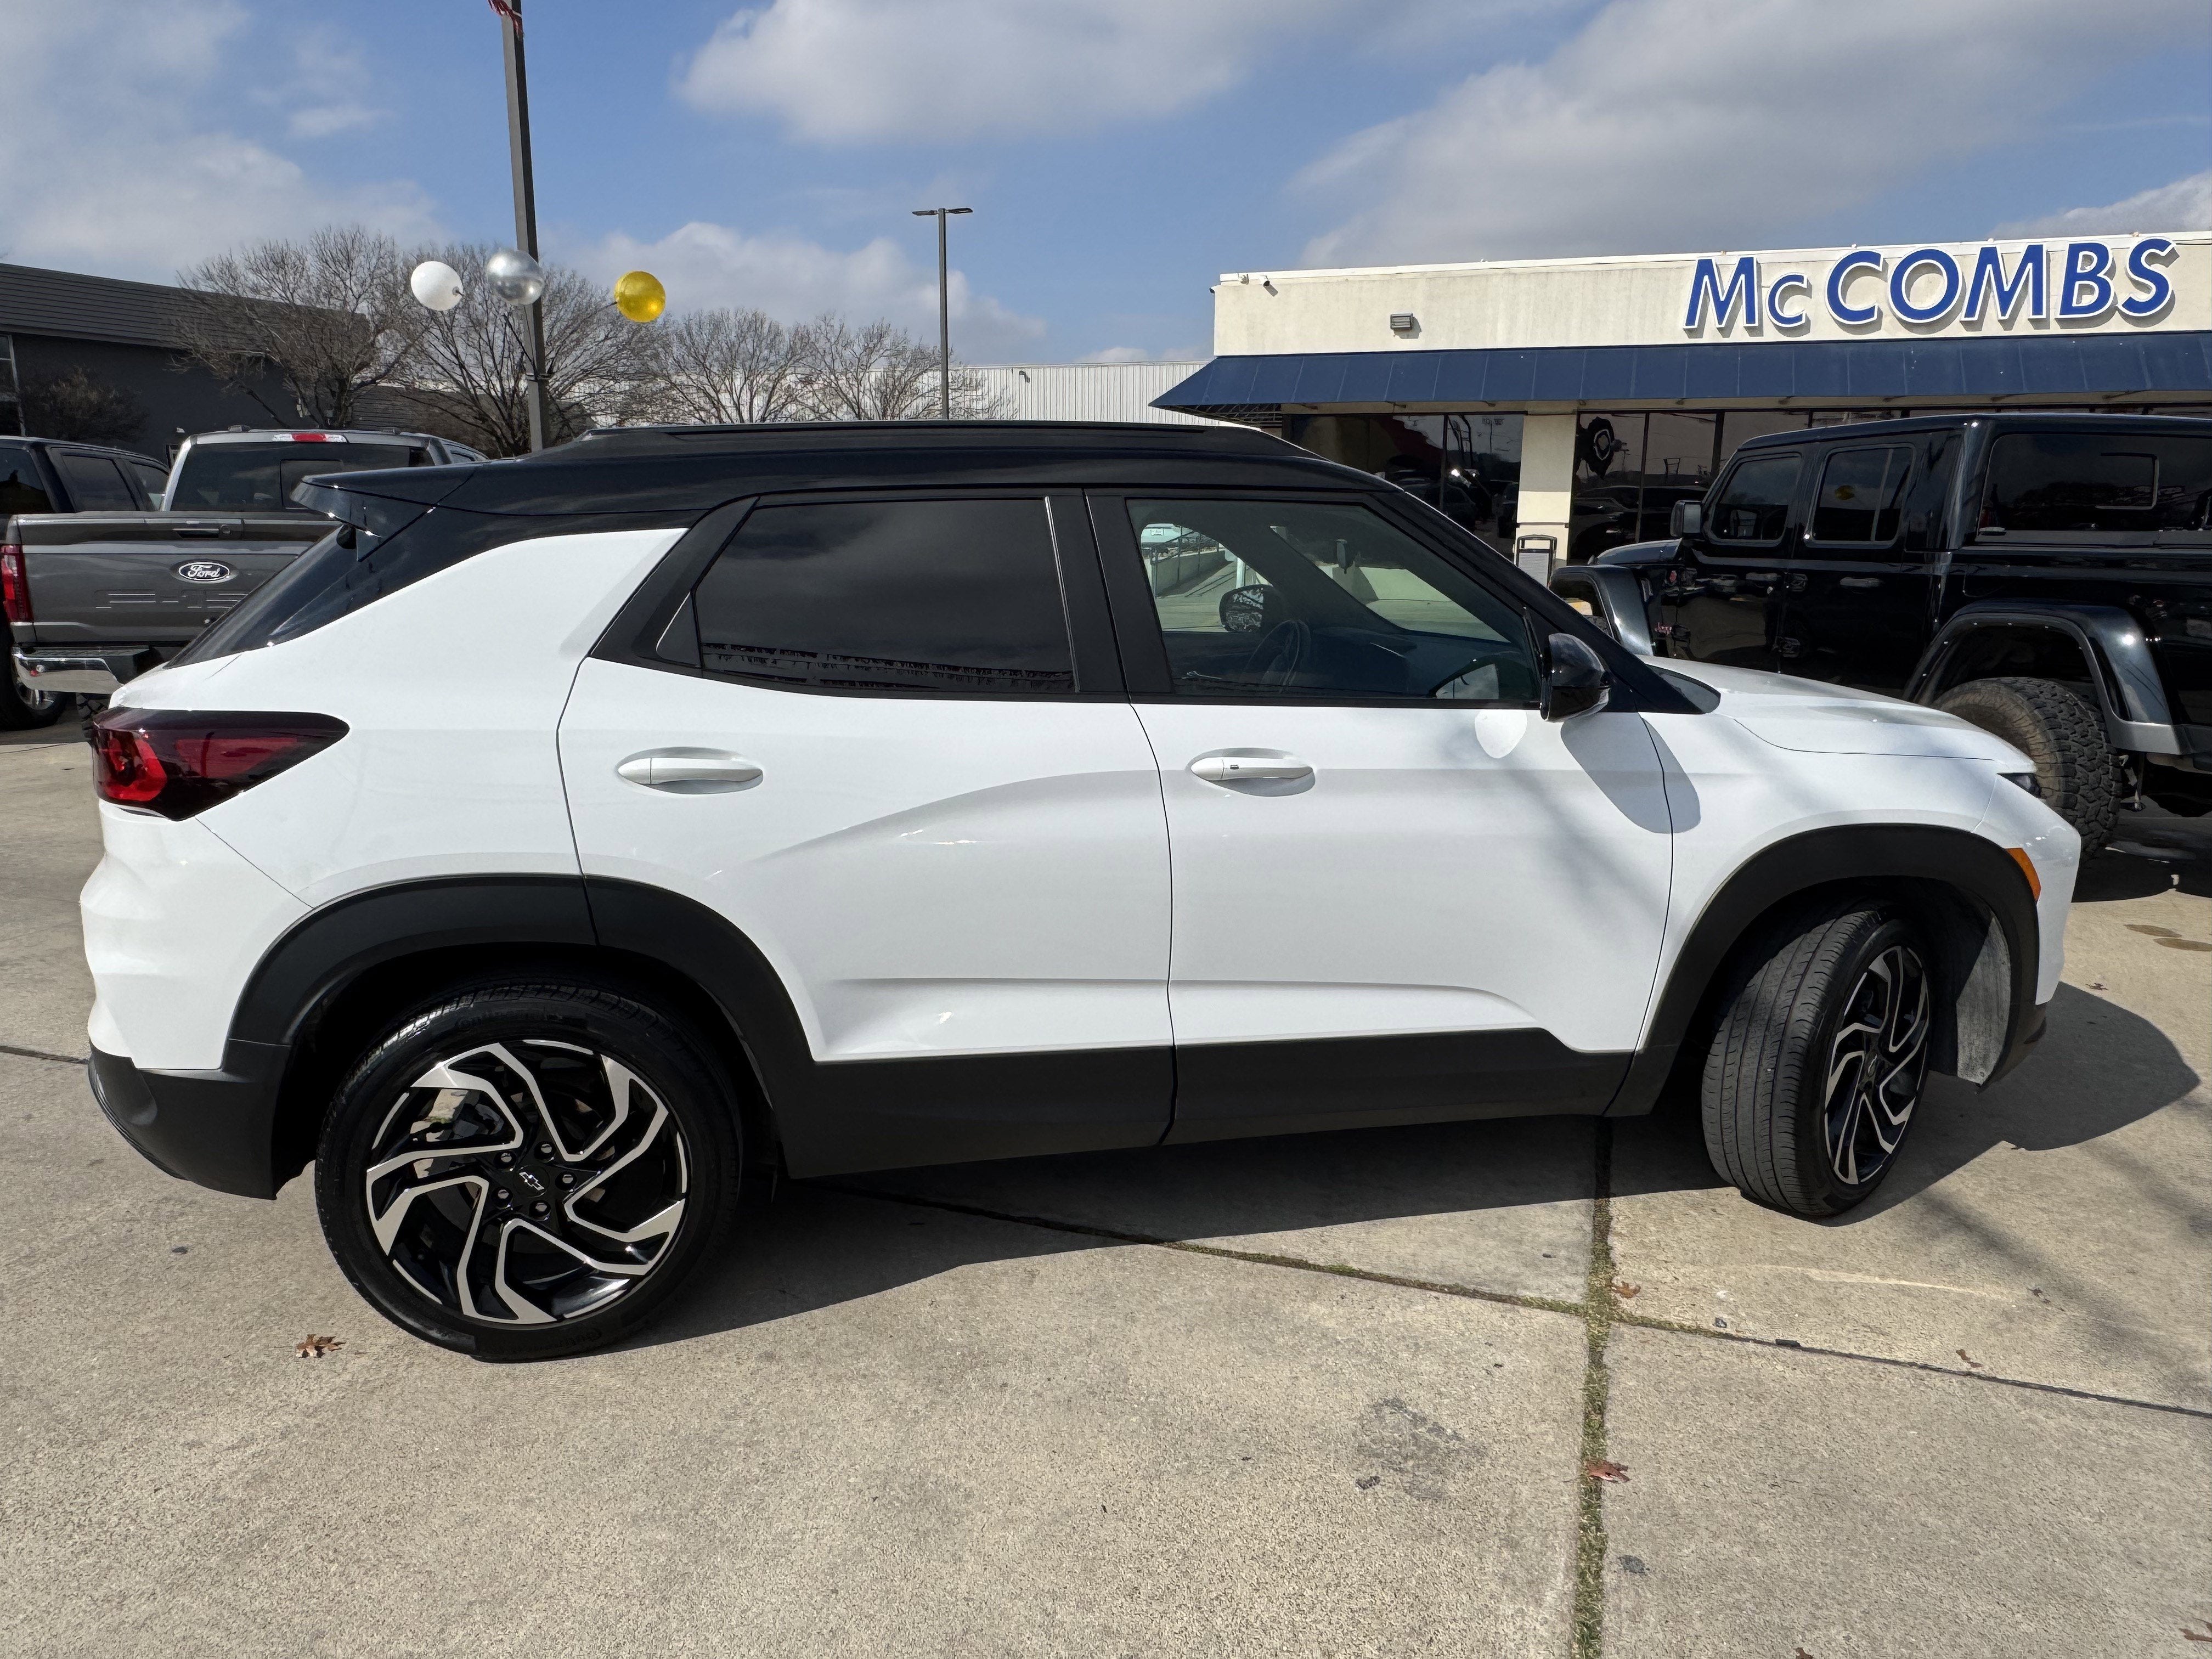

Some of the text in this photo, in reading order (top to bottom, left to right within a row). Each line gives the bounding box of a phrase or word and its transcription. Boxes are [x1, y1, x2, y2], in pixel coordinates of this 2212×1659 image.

[1683, 236, 2176, 328] McCOMBS
[188, 565, 220, 577] Ford
[94, 589, 249, 610] F-15
